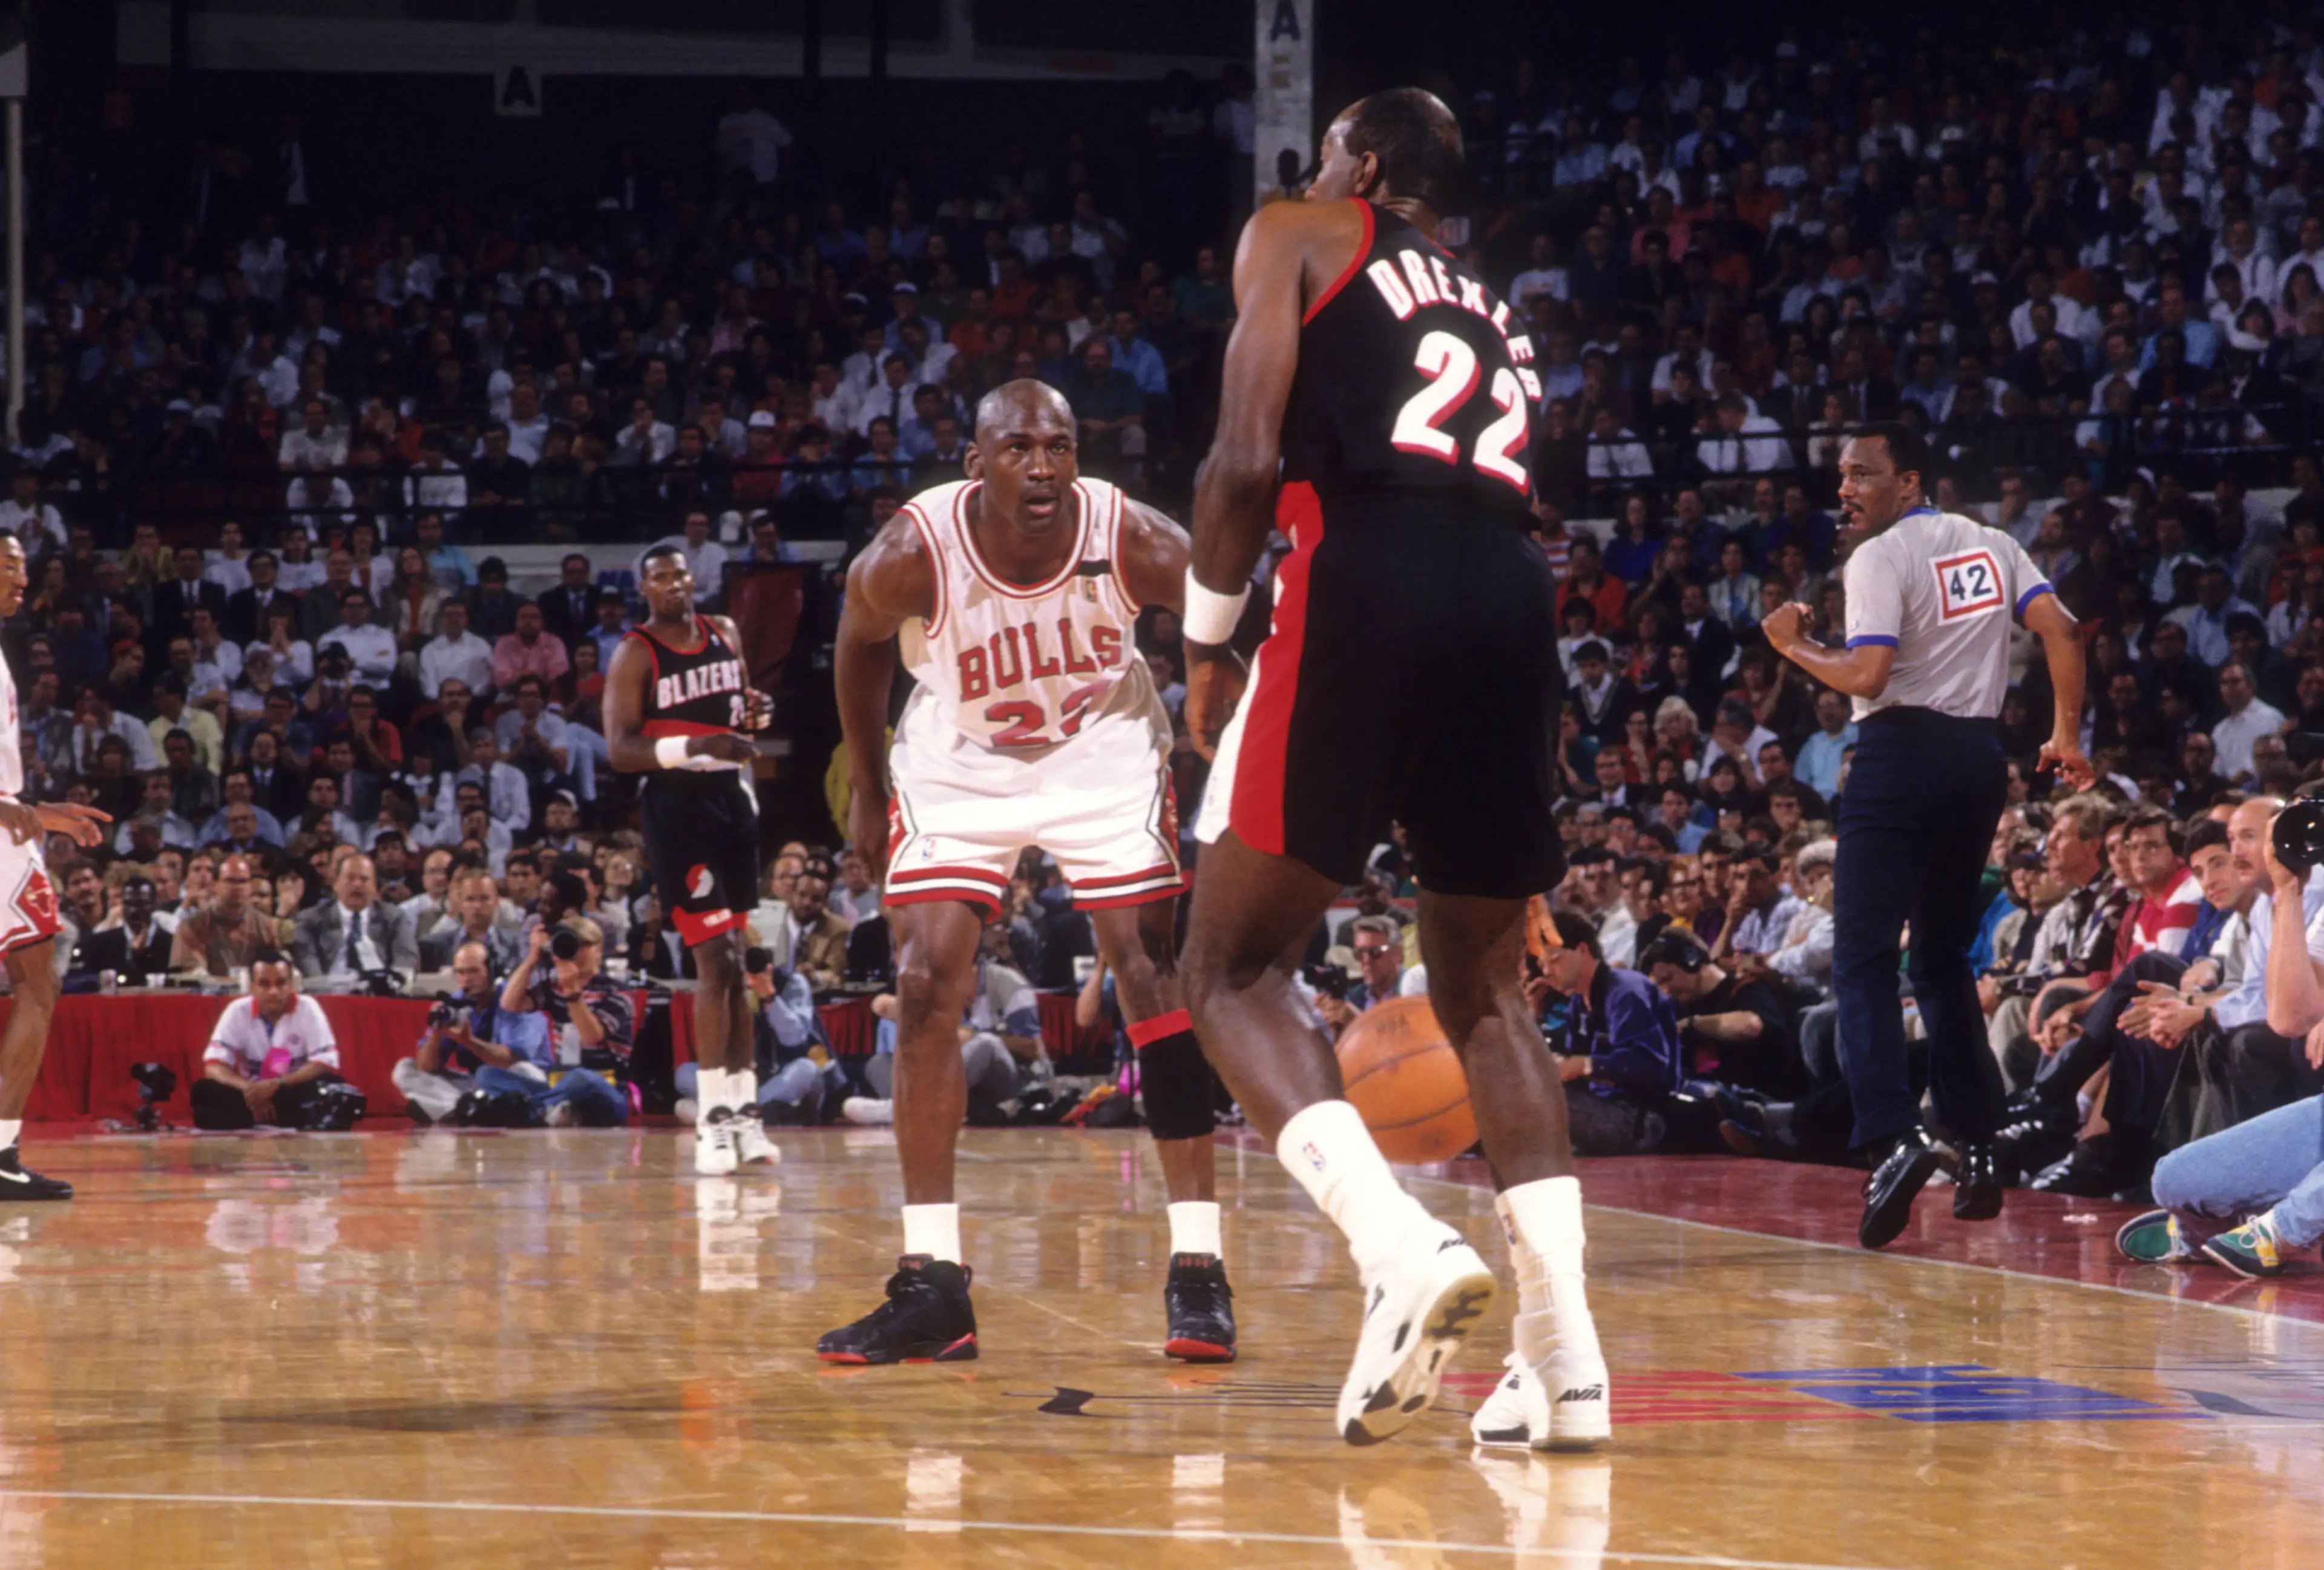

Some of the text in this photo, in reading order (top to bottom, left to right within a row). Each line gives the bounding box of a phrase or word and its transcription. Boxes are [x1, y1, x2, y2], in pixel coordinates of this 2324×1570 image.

[1271, 0, 1301, 42] A
[502, 66, 534, 107] A
[1366, 249, 1543, 401] DREXLER
[1390, 330, 1530, 496] 22
[1951, 564, 1992, 600] 42
[958, 617, 1121, 703] BULLS
[1555, 1384, 1604, 1405] AVIA
